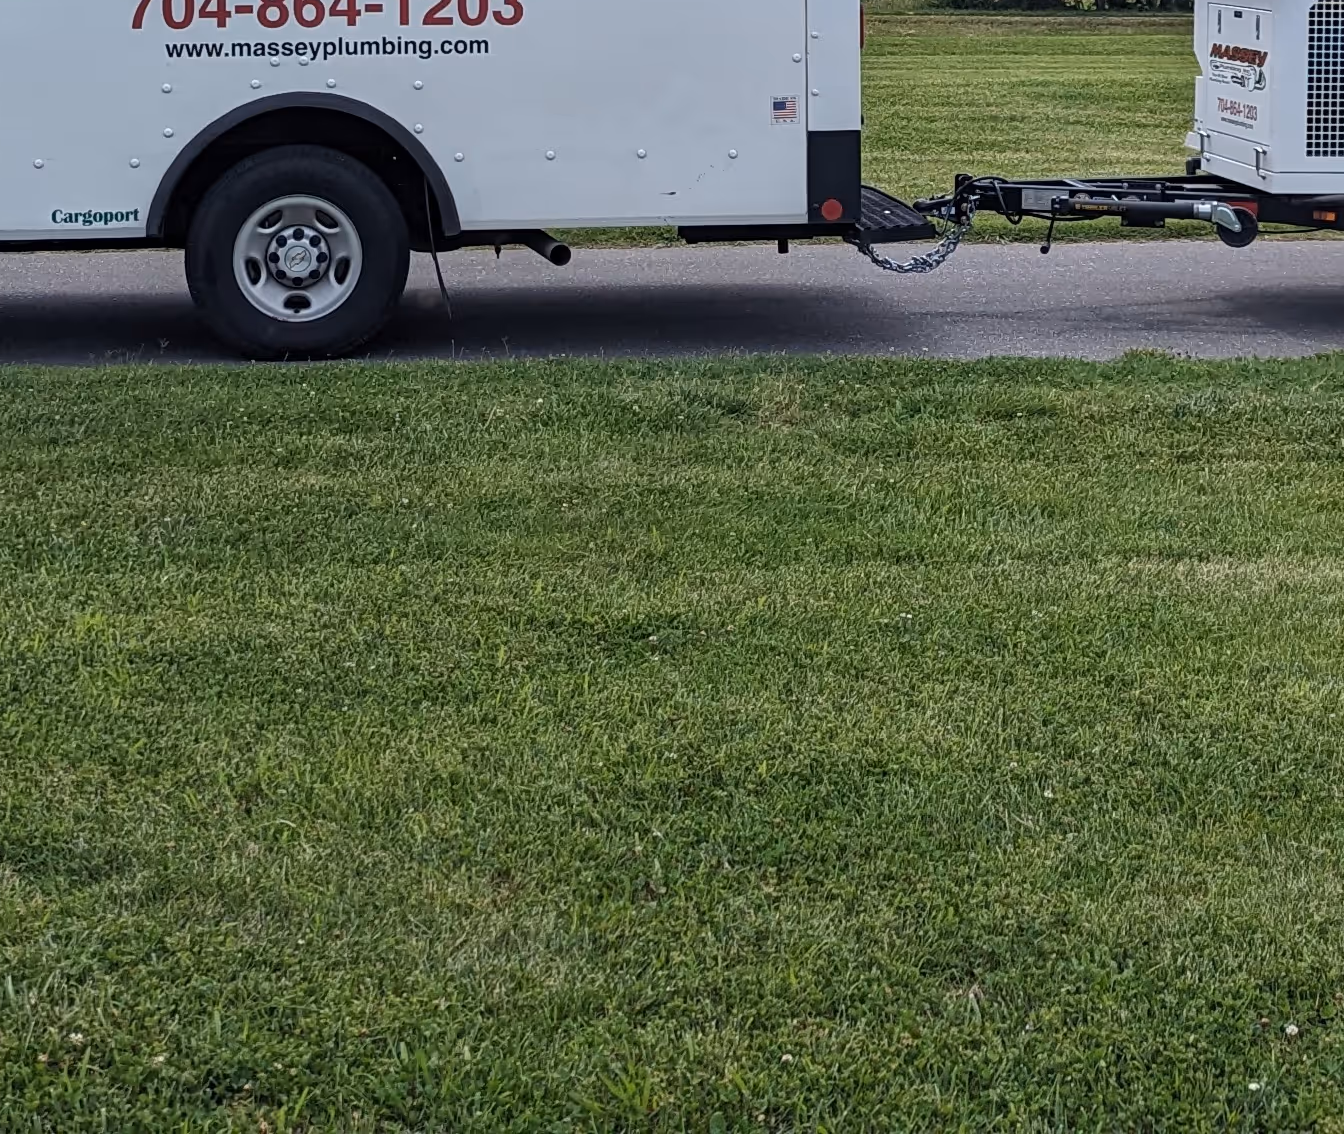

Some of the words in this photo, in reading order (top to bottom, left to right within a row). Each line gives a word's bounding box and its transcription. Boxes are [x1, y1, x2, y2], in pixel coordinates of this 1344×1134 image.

[165, 36, 490, 61] www.masseyplumbing.com
[1209, 42, 1269, 68] MASSEY
[1217, 97, 1258, 122] 704-864-1203
[51, 208, 140, 226] Cargoport
